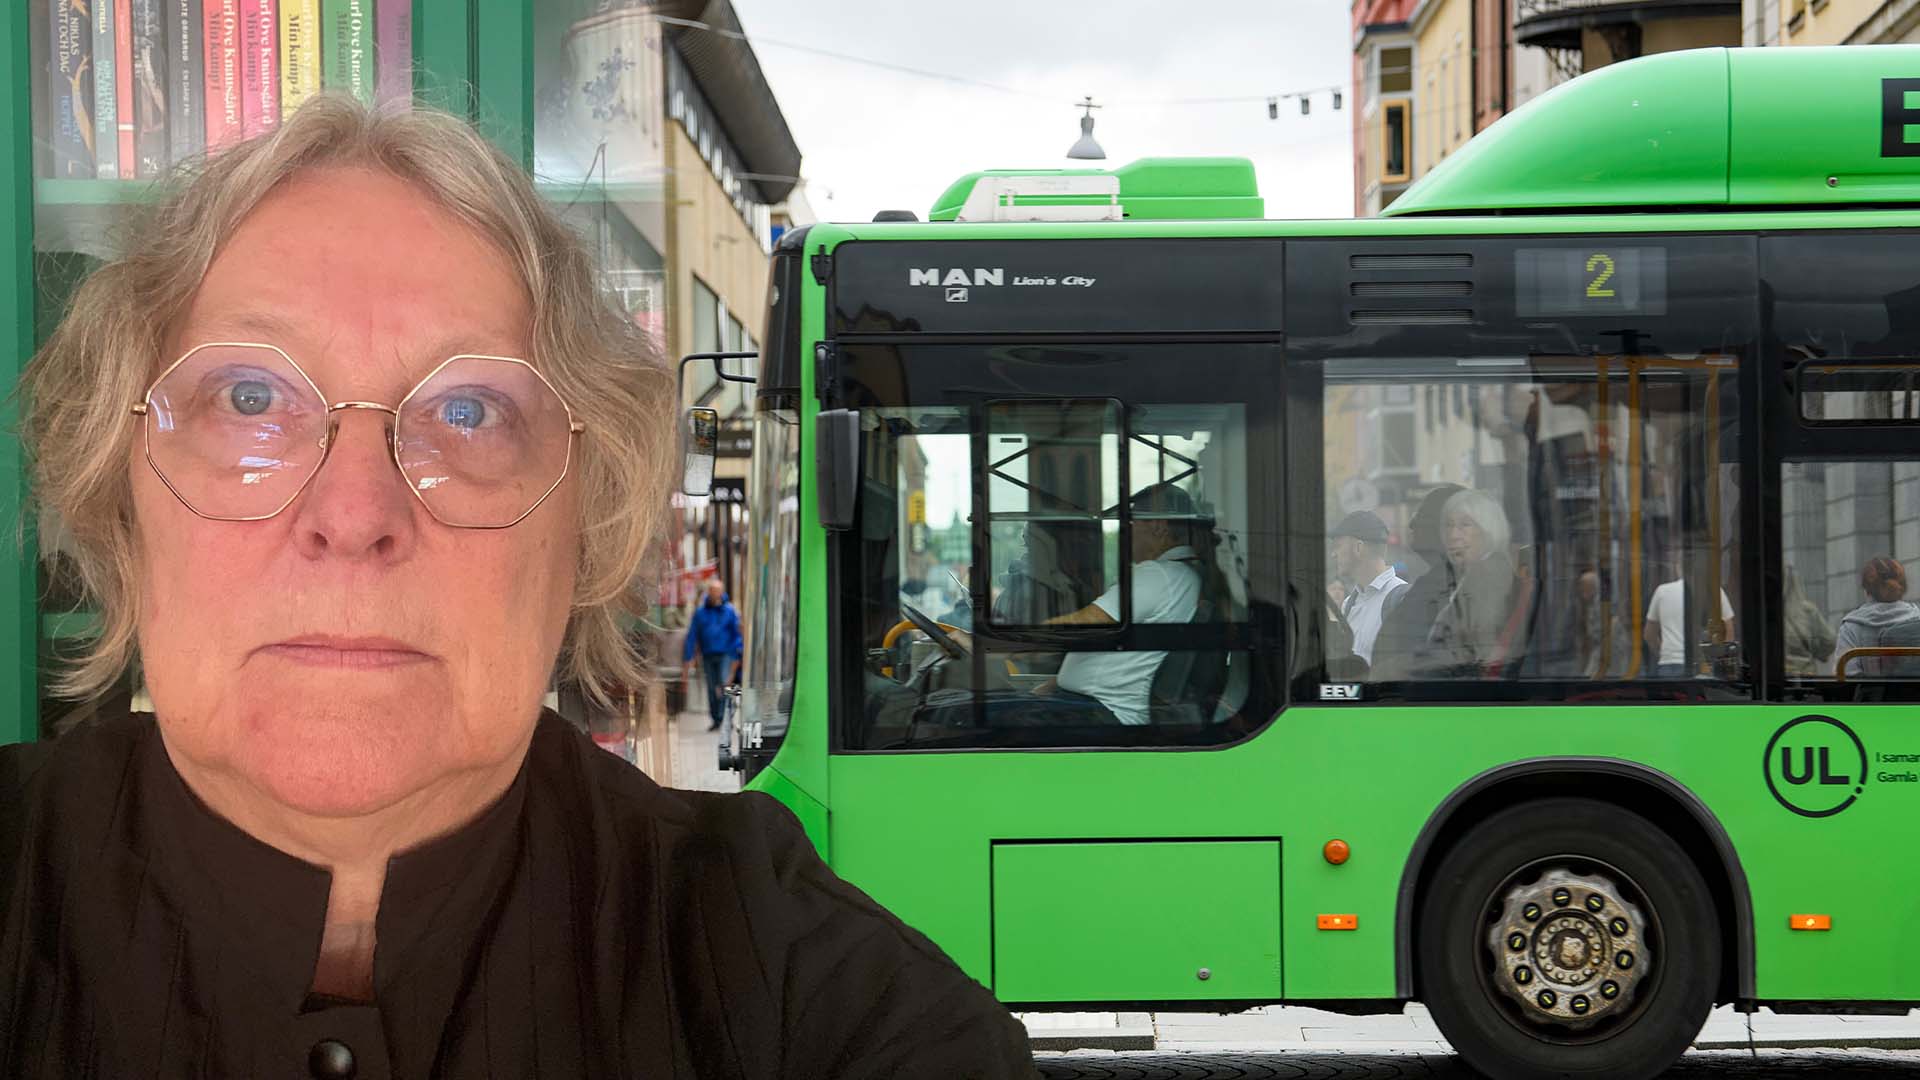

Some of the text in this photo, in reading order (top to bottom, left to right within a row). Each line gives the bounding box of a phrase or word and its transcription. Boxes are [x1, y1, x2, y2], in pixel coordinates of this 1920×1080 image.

[59, 25, 69, 49] OCH
[69, 16, 80, 57] NIKLAS
[224, 18, 234, 46] Ove
[261, 18, 271, 46] Ove
[351, 19, 361, 47] Ove
[60, 51, 70, 73] DAG
[287, 14, 301, 96] Min kamp 4
[909, 268, 1096, 287] MAN Lion's City
[1586, 254, 1615, 297] 2
[1320, 685, 1360, 698] EEV
[1781, 746, 1850, 785] UL
[1877, 771, 1918, 782] Gamla
